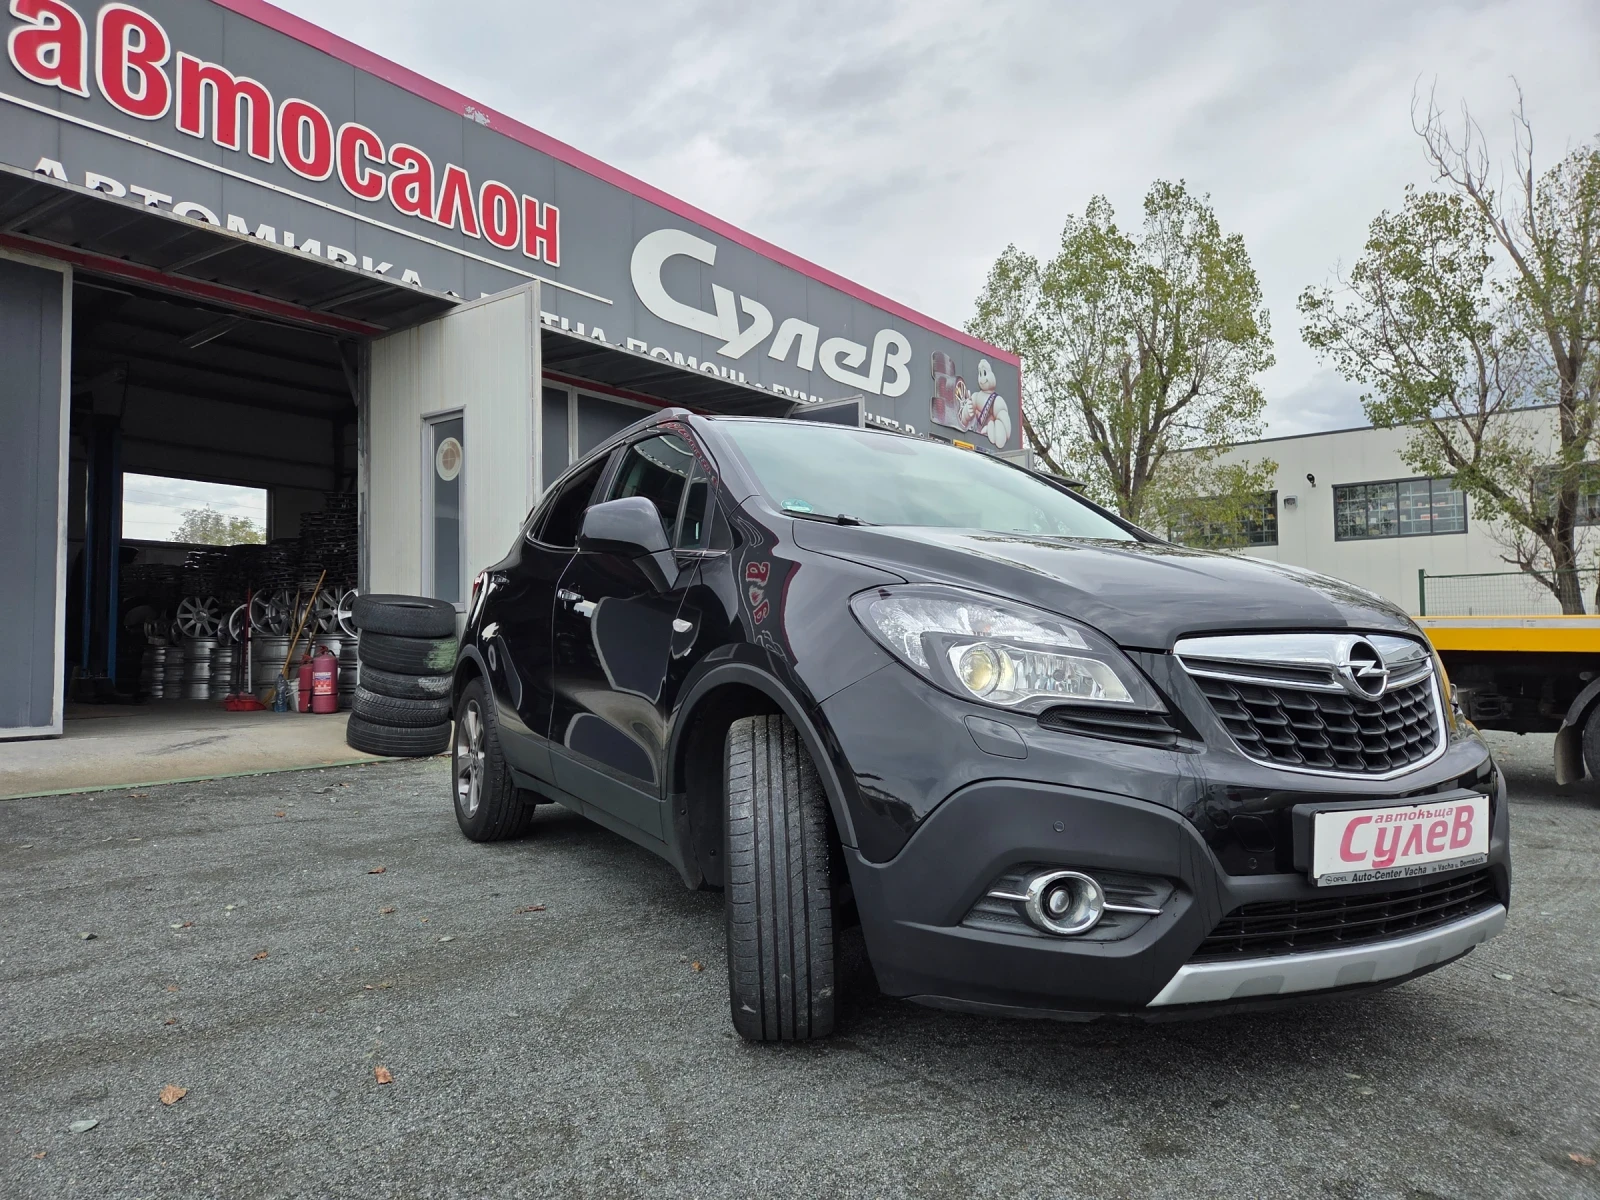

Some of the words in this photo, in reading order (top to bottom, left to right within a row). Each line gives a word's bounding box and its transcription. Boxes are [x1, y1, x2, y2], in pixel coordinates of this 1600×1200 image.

[1374, 807, 1454, 824] автокъща
[1351, 869, 1403, 883] Auto-Center
[1404, 866, 1427, 877] Vacha
[1438, 863, 1454, 871] Vacha
